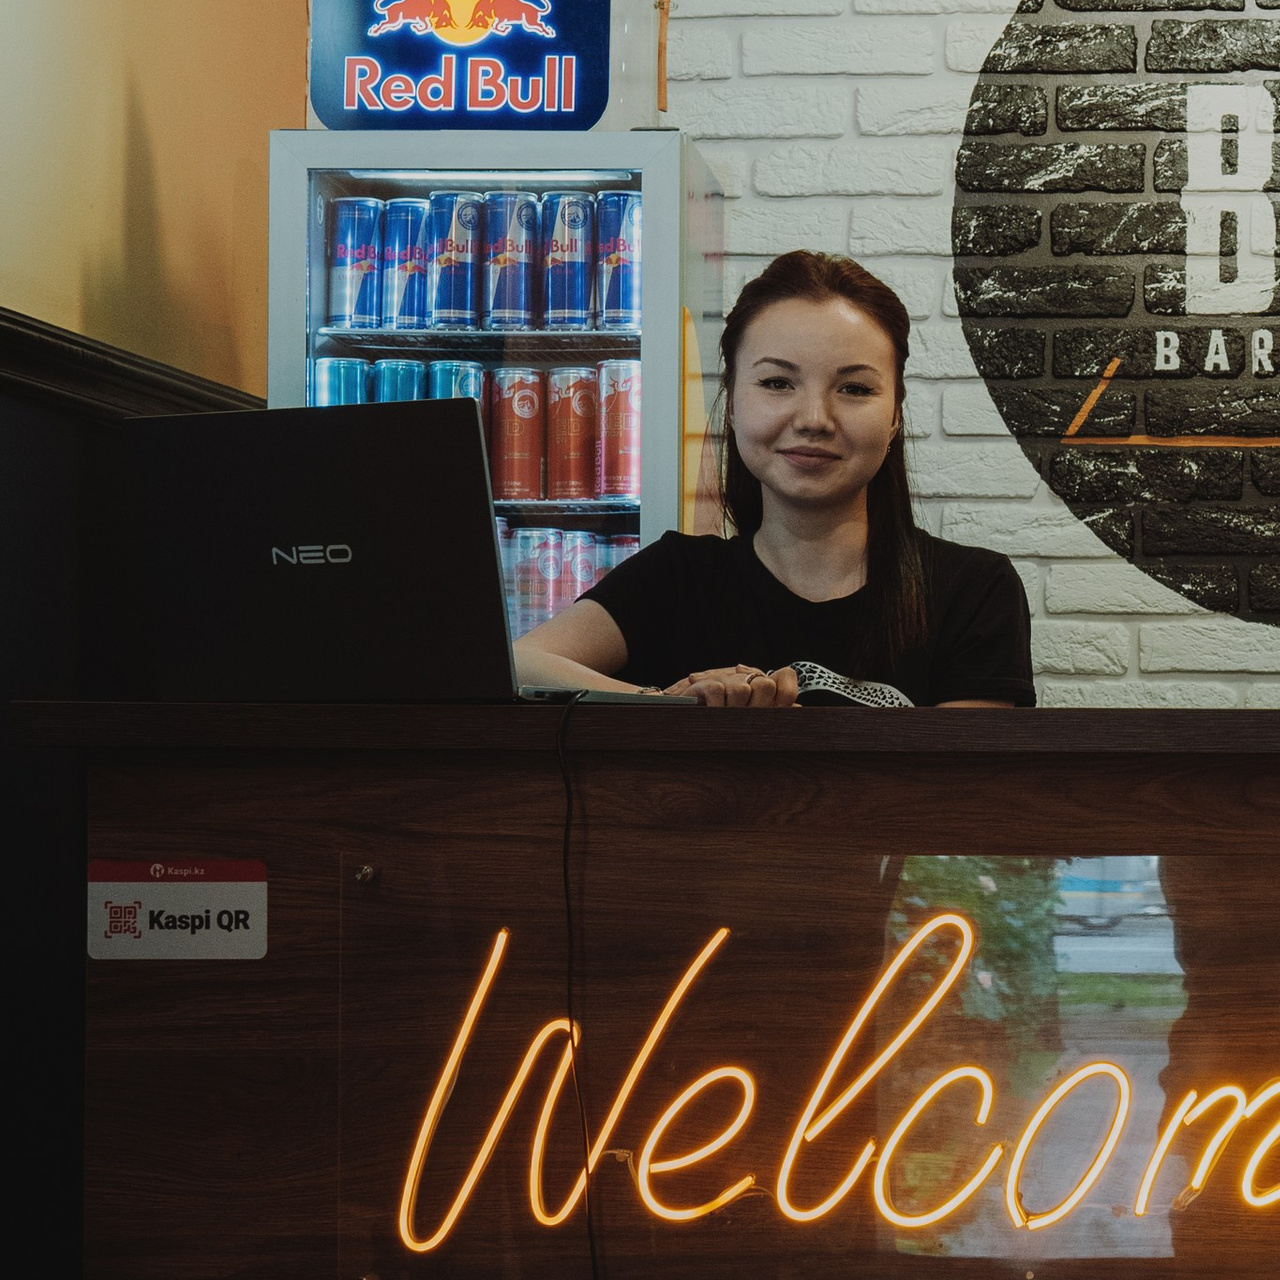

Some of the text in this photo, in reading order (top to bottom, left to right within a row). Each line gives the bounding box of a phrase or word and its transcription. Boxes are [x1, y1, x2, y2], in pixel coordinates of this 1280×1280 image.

[343, 54, 576, 112] Red Bull
[337, 244, 365, 259] Red
[504, 238, 532, 254] Bull
[551, 238, 578, 253] Bull
[271, 543, 353, 566] NEO
[168, 866, 205, 877] Kaspi.kz
[149, 909, 250, 935] Kaspi QR
